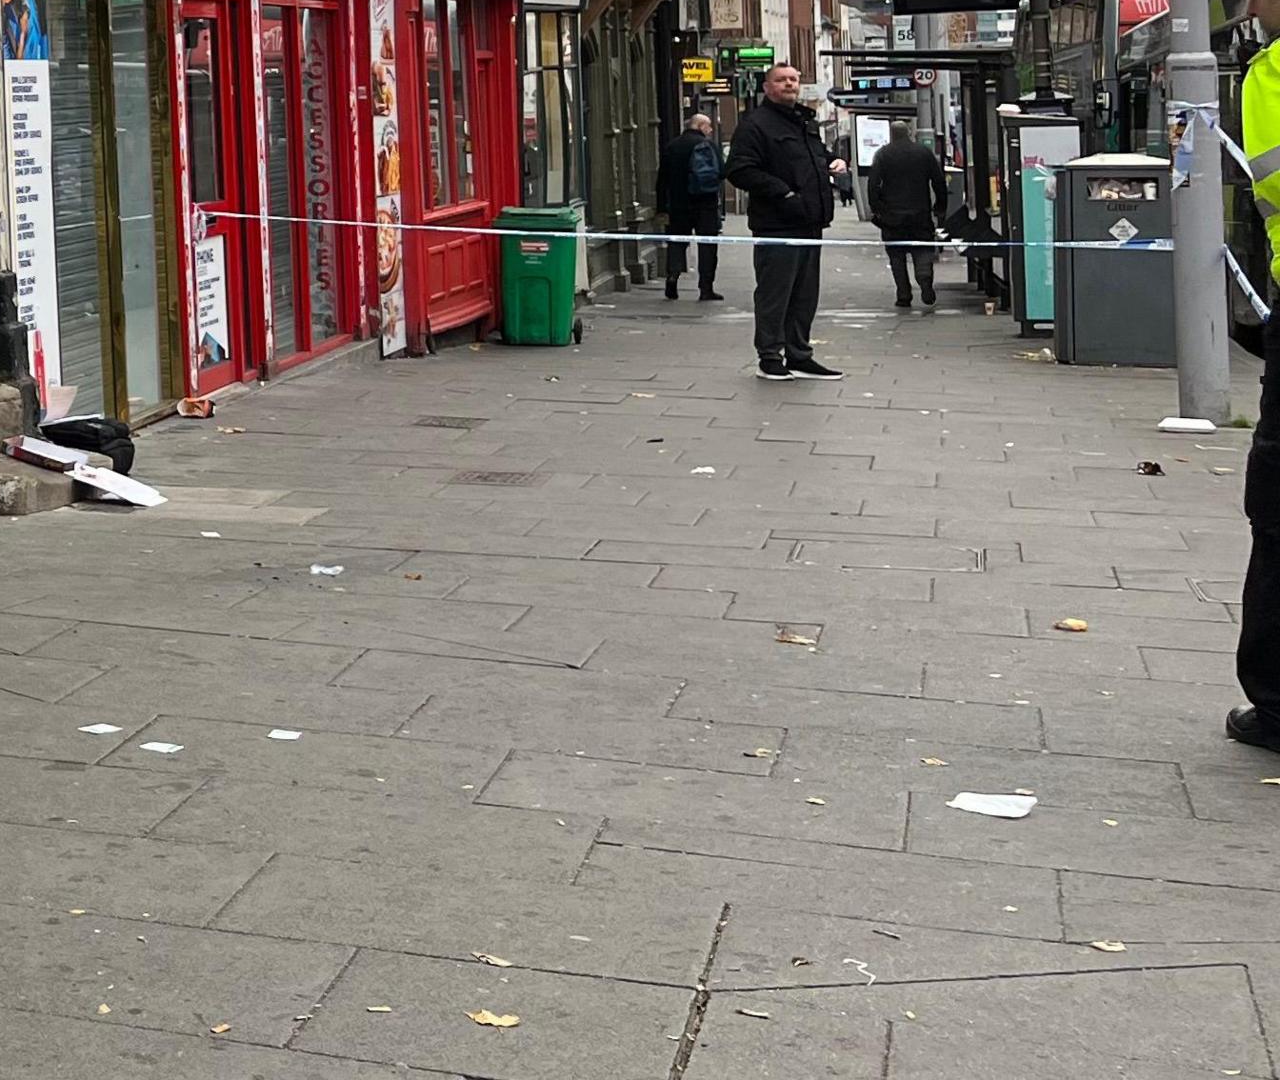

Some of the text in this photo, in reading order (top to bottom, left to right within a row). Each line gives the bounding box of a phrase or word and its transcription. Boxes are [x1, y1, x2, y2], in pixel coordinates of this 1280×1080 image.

[682, 62, 710, 70] AVEL
[916, 70, 933, 80] 20
[307, 37, 331, 292] ACCESSORIES
